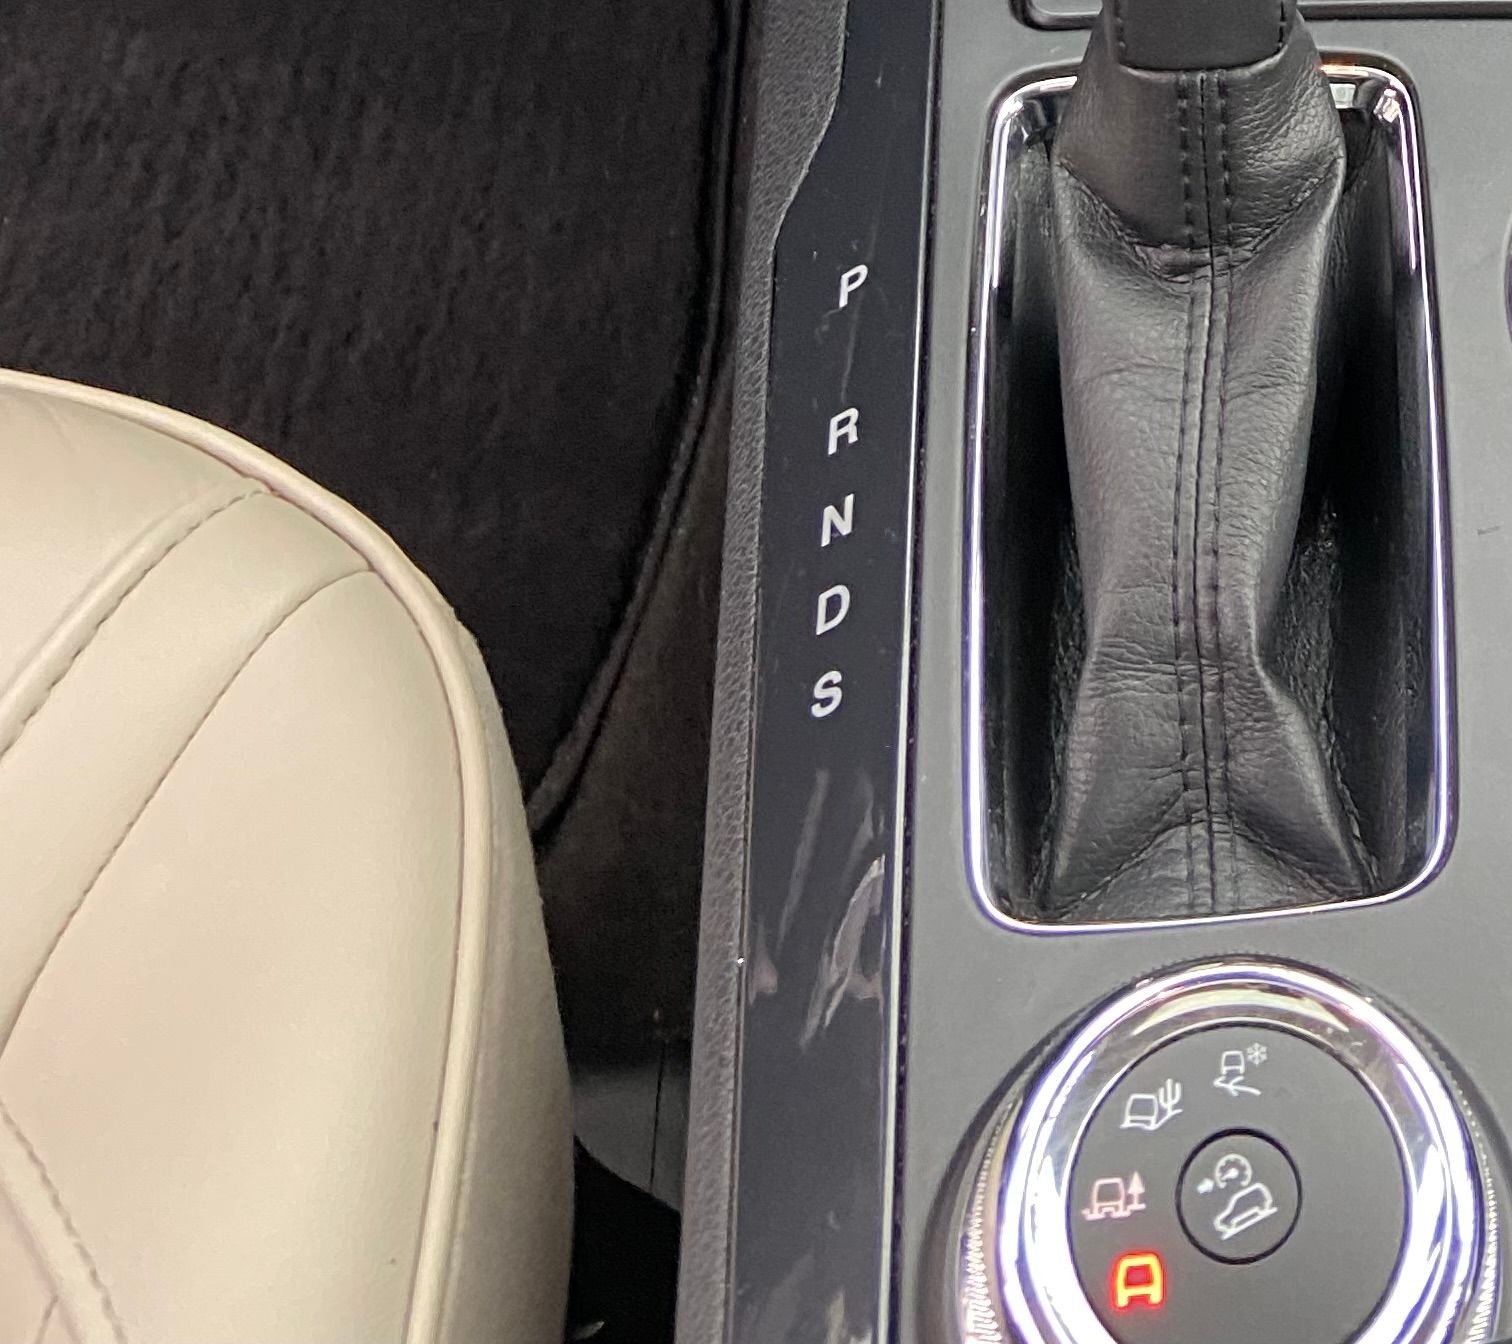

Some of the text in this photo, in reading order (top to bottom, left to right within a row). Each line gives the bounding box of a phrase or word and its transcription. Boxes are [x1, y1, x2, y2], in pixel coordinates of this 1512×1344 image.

[838, 264, 868, 310] P
[828, 407, 860, 455] R
[820, 493, 855, 548] N
[814, 584, 851, 636] D
[810, 670, 844, 718] S
